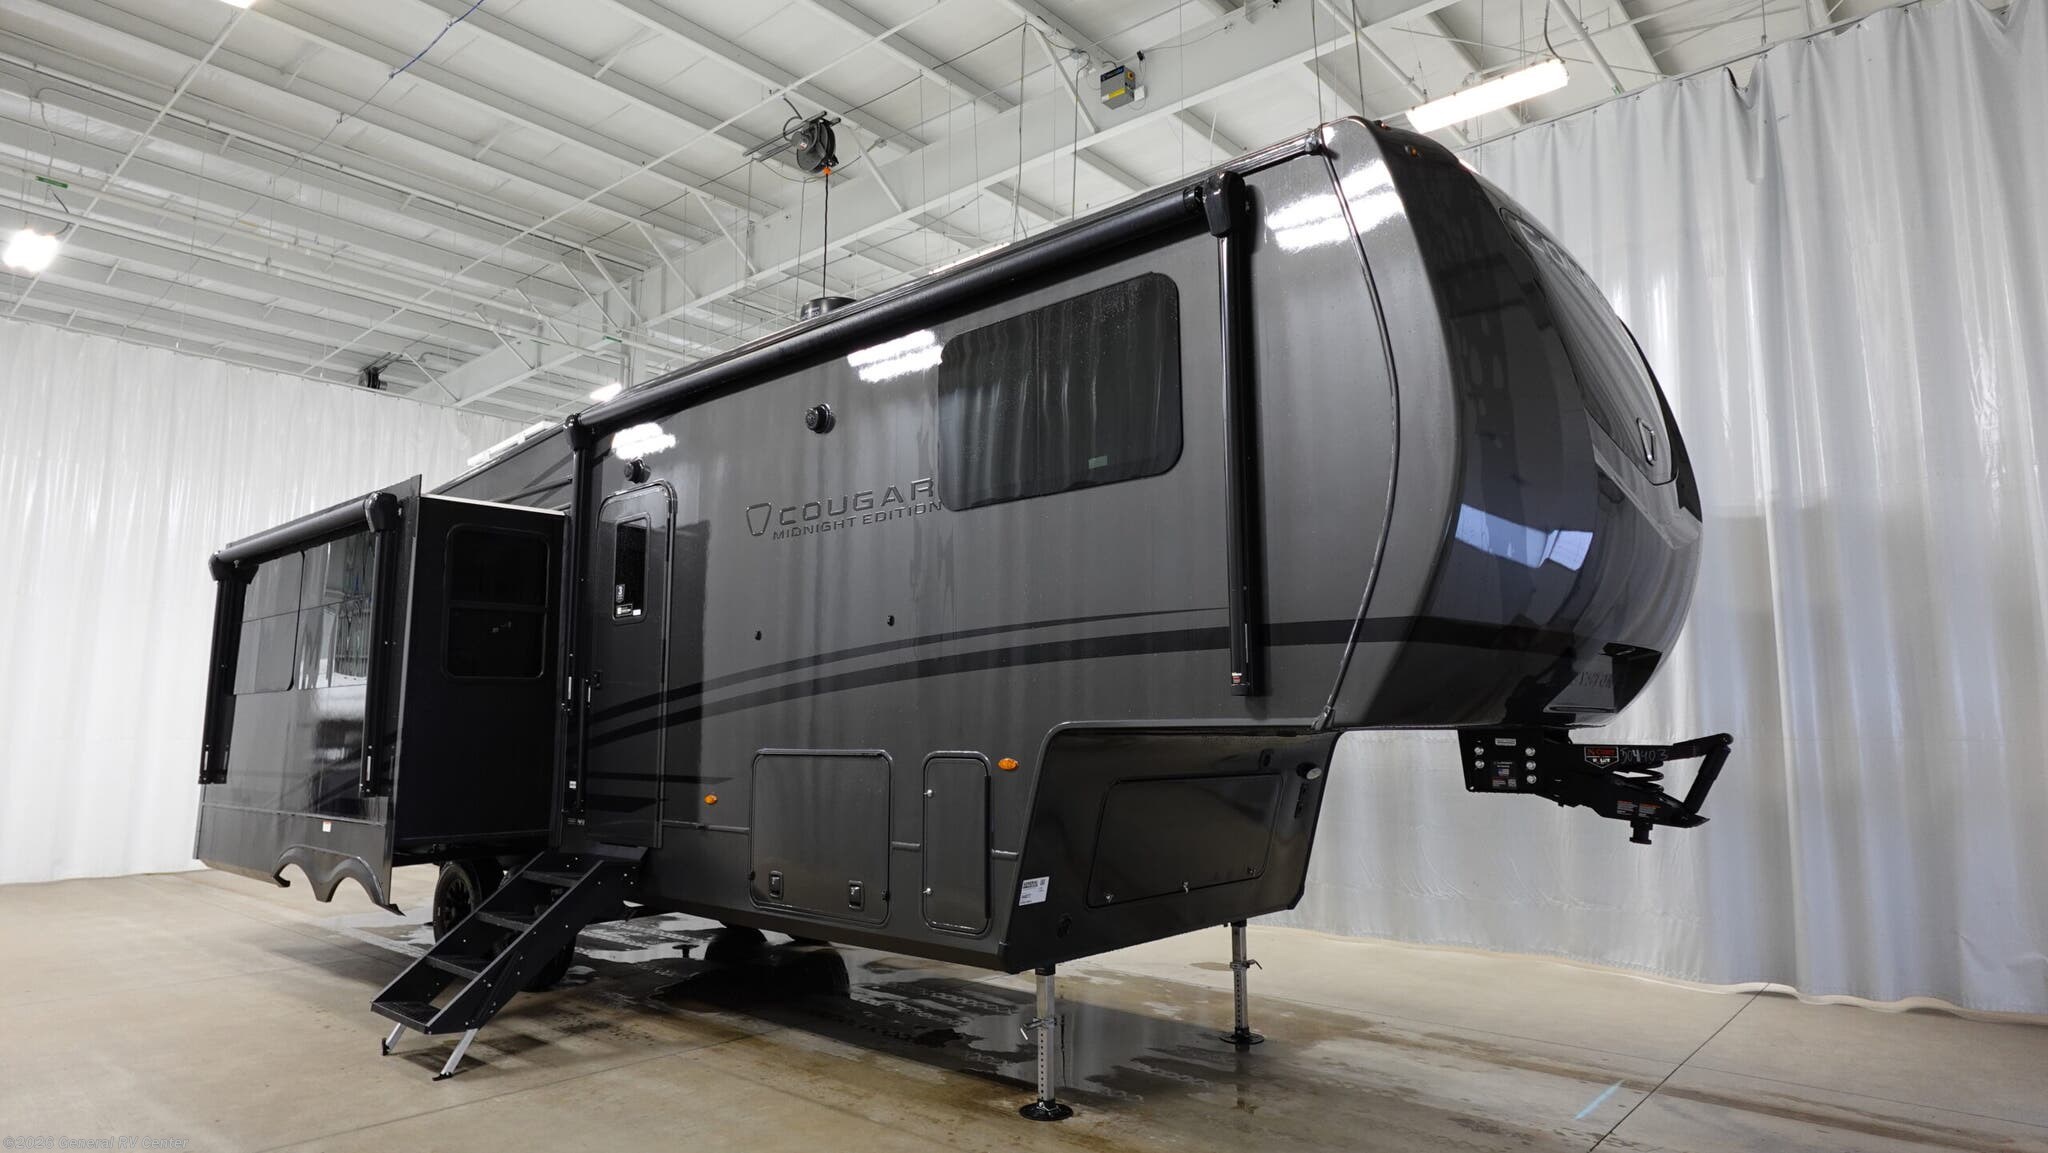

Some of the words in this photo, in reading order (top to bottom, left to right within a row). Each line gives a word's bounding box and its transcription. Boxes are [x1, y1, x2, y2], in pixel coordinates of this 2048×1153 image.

[772, 516, 857, 541] MIDNIGHT
[861, 500, 943, 526] EDITION
[779, 477, 935, 526] COUGAR
